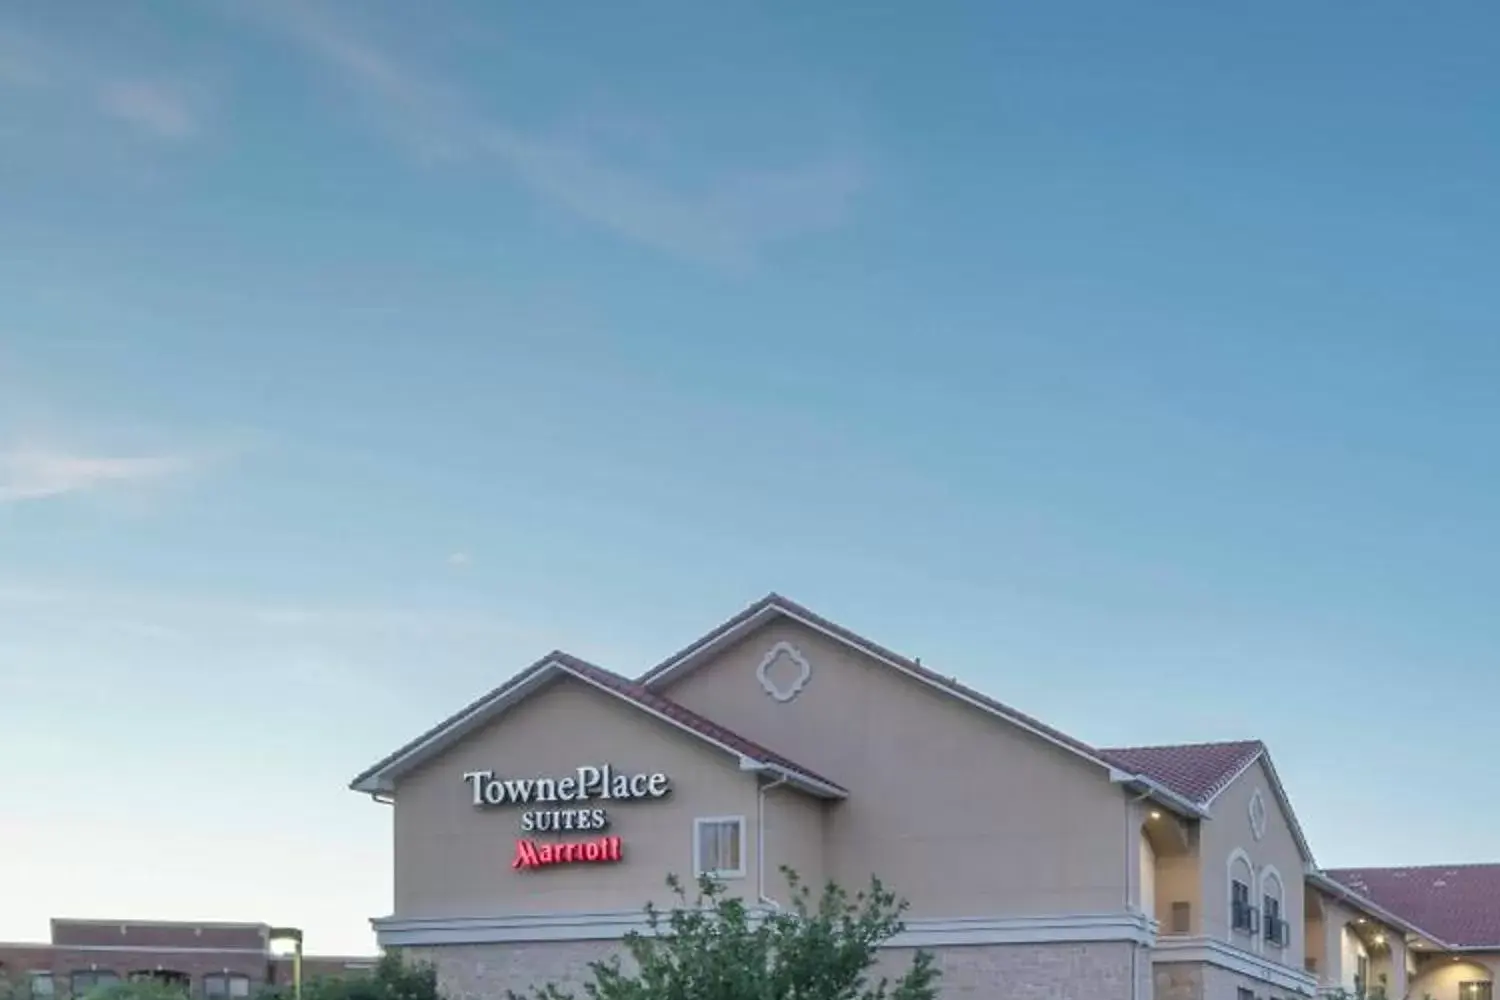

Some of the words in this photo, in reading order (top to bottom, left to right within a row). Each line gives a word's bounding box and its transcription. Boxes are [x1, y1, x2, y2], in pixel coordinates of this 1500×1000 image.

[463, 762, 669, 806] TownePlace
[521, 808, 606, 831] SUITES
[512, 835, 622, 869] Marriott
